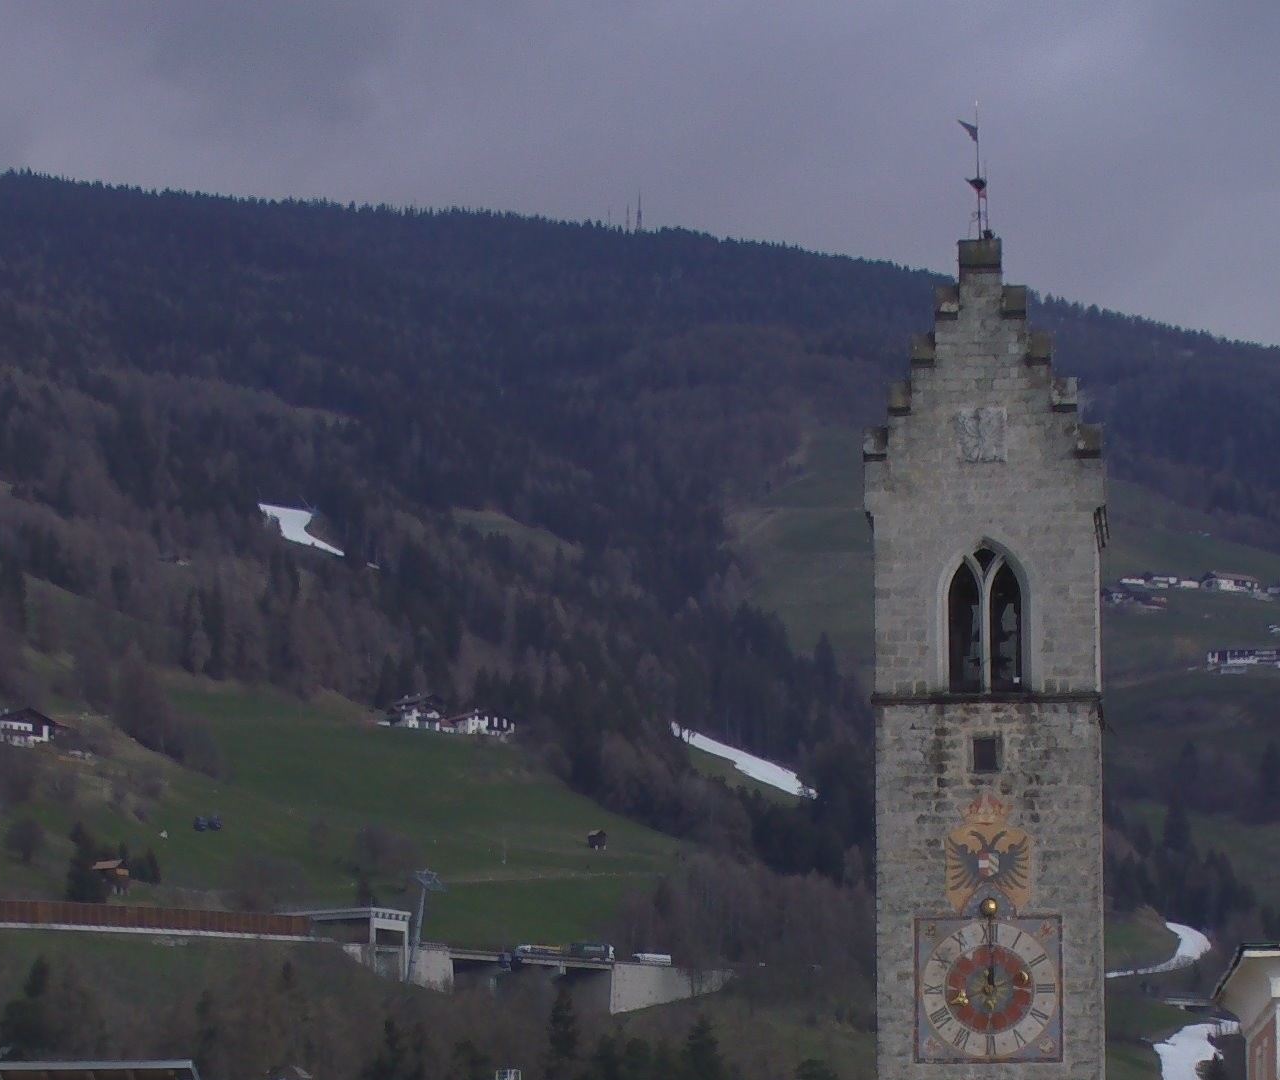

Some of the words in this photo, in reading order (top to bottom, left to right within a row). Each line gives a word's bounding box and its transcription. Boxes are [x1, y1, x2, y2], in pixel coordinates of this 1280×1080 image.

[1011, 931, 1022, 948] I
[1029, 953, 1048, 968] II
[1036, 983, 1056, 993] III
